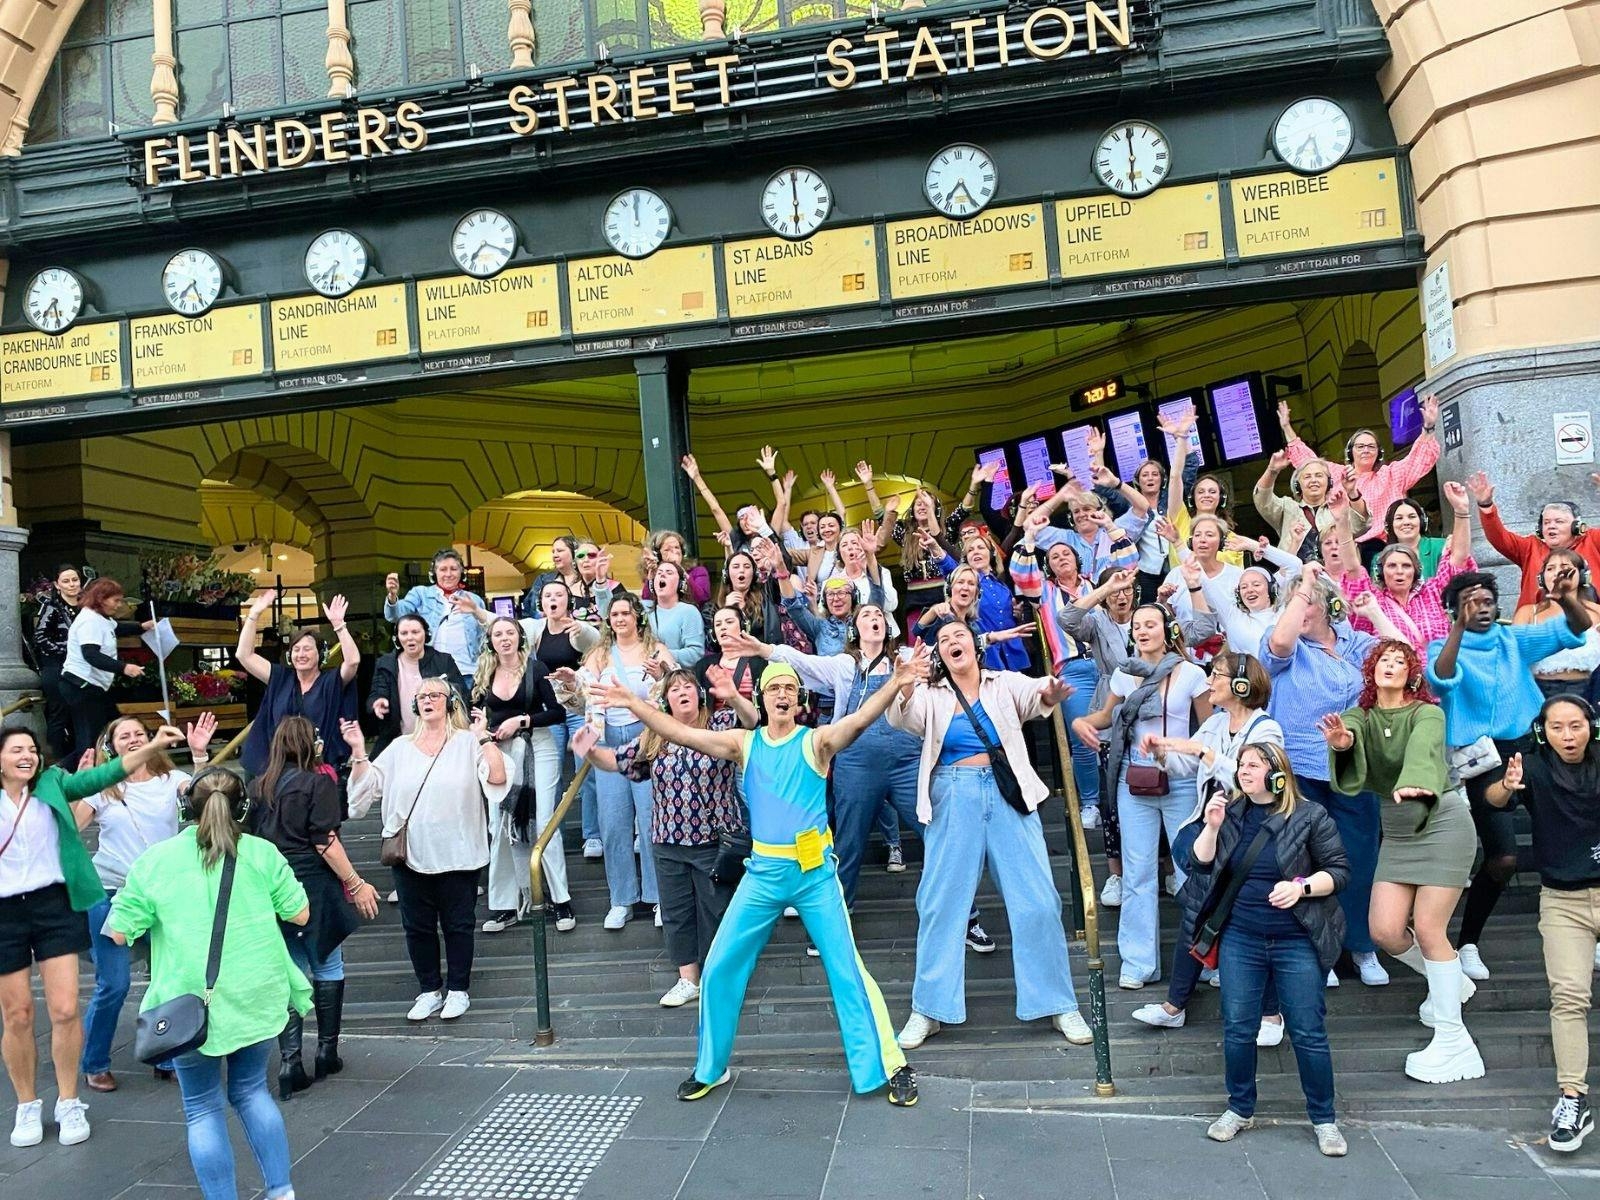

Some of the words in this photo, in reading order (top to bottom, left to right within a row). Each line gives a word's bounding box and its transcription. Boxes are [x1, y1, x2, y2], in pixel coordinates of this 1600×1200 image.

[144, 101, 428, 187] FLINDERS
[508, 54, 741, 135] STREET
[826, 0, 1131, 90] STATION
[1242, 176, 1329, 201] WERRIBEE
[1066, 201, 1132, 222] UPFIELD
[1243, 205, 1280, 224] LINE
[895, 213, 1031, 245] BROADMEADOWS
[1067, 226, 1103, 244] LINE
[1246, 227, 1310, 244] PLATFORM
[733, 248, 753, 264] ST
[755, 241, 814, 262] ALBANS
[897, 248, 931, 266] LINE
[1069, 249, 1130, 265] PLATFORM
[577, 262, 634, 281] ALTONA
[1280, 261, 1305, 272] NEXT
[1308, 257, 1339, 269] TRAIN
[1341, 254, 1361, 265] FOR
[734, 268, 767, 285] LINE
[899, 270, 957, 286] PLATFORM
[1105, 282, 1129, 292] NEXT
[1132, 278, 1162, 290] TRAIN
[1163, 274, 1183, 285] FOR
[425, 275, 534, 301] WILLIAMSTOWN
[577, 285, 609, 302] LINE
[736, 290, 793, 305] PLATFORM
[278, 295, 377, 321] SANDRINGHAM
[426, 305, 457, 321] LINE
[579, 307, 634, 322] PLATFORM
[895, 307, 918, 317] NEXT
[920, 304, 949, 315] TRAIN
[951, 301, 969, 311] FOR
[134, 318, 213, 340] FRANKSTON
[279, 324, 309, 341] LINE
[427, 326, 480, 340] PLATFORM
[734, 326, 756, 335] NEXT
[759, 323, 785, 333] TRAIN
[787, 320, 806, 330] FOR
[3, 336, 65, 356] PAKENHAM
[71, 333, 90, 348] and
[135, 343, 164, 359] LINE
[281, 344, 332, 359] PLATFORM
[574, 343, 591, 352] NEXT
[593, 341, 614, 350] TRAIN
[615, 338, 630, 347] FOR
[4, 353, 82, 375] CRANBOURNE
[85, 349, 118, 366] LINES
[136, 363, 186, 377] PLATFORM
[424, 361, 446, 370] NEXT
[448, 358, 473, 368] TRAIN
[474, 355, 491, 365] FOR
[4, 379, 53, 392] PLATFORM
